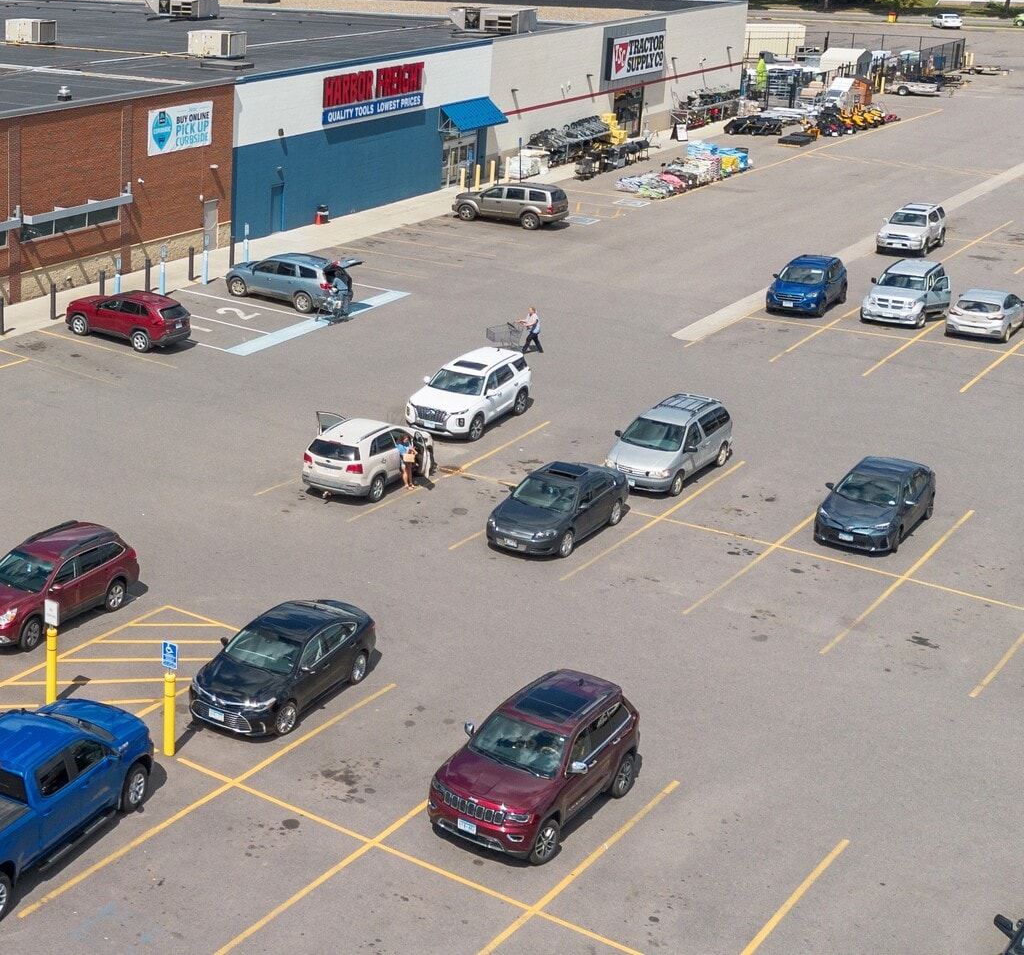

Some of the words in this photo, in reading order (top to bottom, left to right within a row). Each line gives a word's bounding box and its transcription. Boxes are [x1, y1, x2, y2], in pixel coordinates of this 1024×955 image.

[615, 44, 626, 66] TSC
[629, 35, 664, 55] TRACTOR
[626, 52, 655, 73] SUPPLY
[323, 70, 373, 108] HARBOR
[376, 62, 424, 98] FREIGHT
[176, 114, 188, 124] BUY
[189, 111, 210, 122] ONLINE
[328, 108, 353, 122] QUALITY
[355, 104, 374, 118] TOOLS
[377, 99, 399, 112] LOWEST
[400, 95, 421, 108] PRICES
[176, 122, 195, 136] PICK
[197, 120, 209, 132] UP
[176, 132, 209, 147] CURBSIDE
[216, 307, 261, 320] 2
